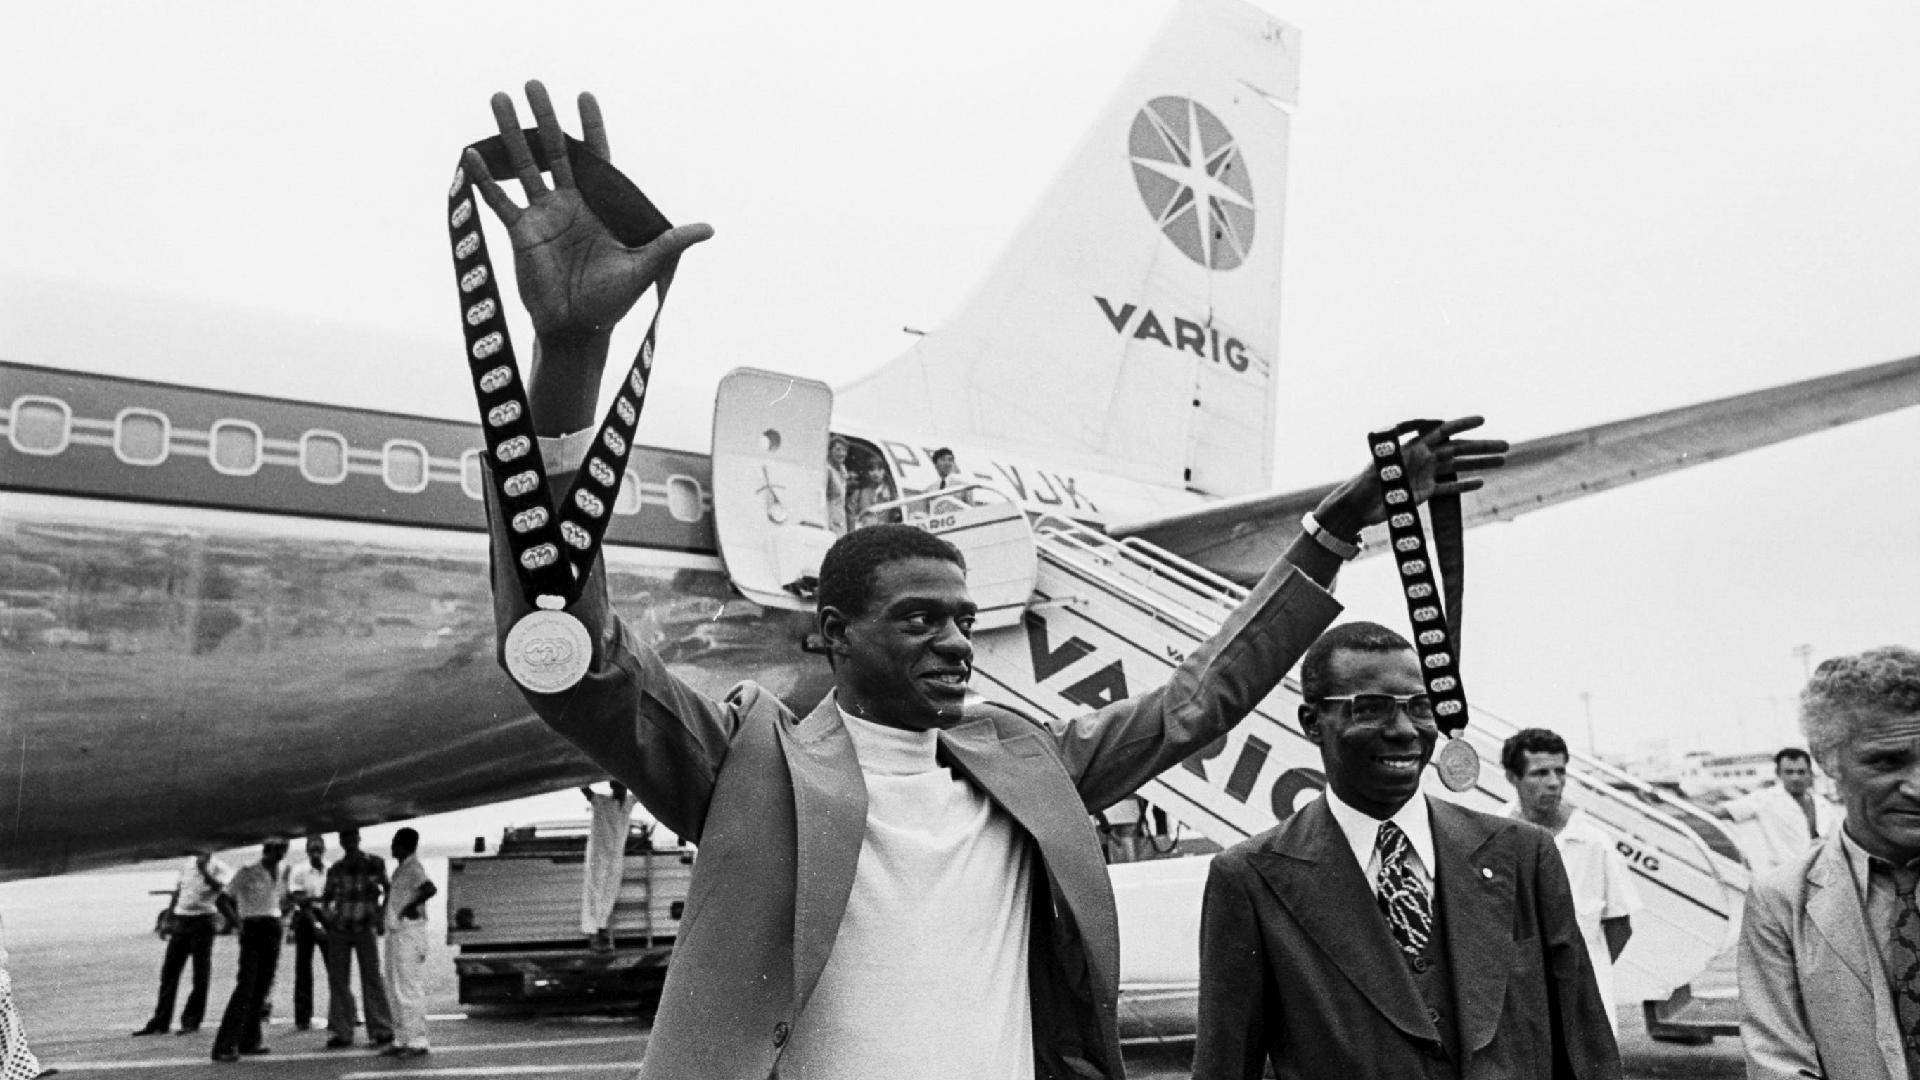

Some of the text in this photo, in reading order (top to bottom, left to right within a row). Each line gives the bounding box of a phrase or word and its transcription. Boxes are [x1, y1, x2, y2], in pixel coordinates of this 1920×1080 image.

[1094, 295, 1249, 373] VARIG
[881, 439, 1098, 513] P-VJK
[1616, 841, 1660, 871] RIG
